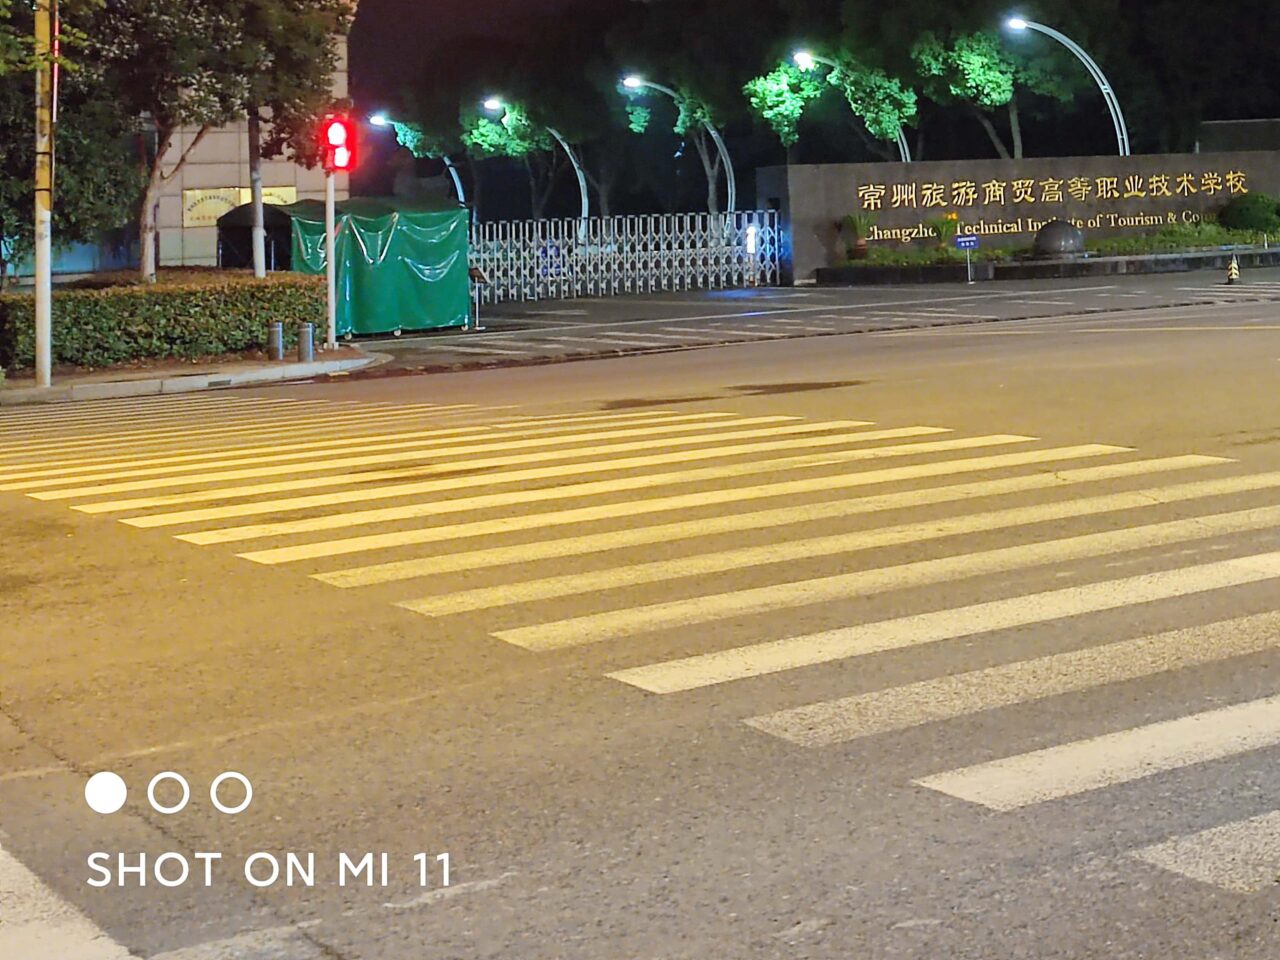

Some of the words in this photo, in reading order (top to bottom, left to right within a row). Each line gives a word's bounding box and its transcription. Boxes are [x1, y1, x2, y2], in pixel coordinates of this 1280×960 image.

[858, 170, 1249, 211] 常州旅游商贸高等职业技术学校
[1087, 213, 1104, 229] of
[1106, 211, 1163, 228] Tourism
[1167, 211, 1178, 224] &
